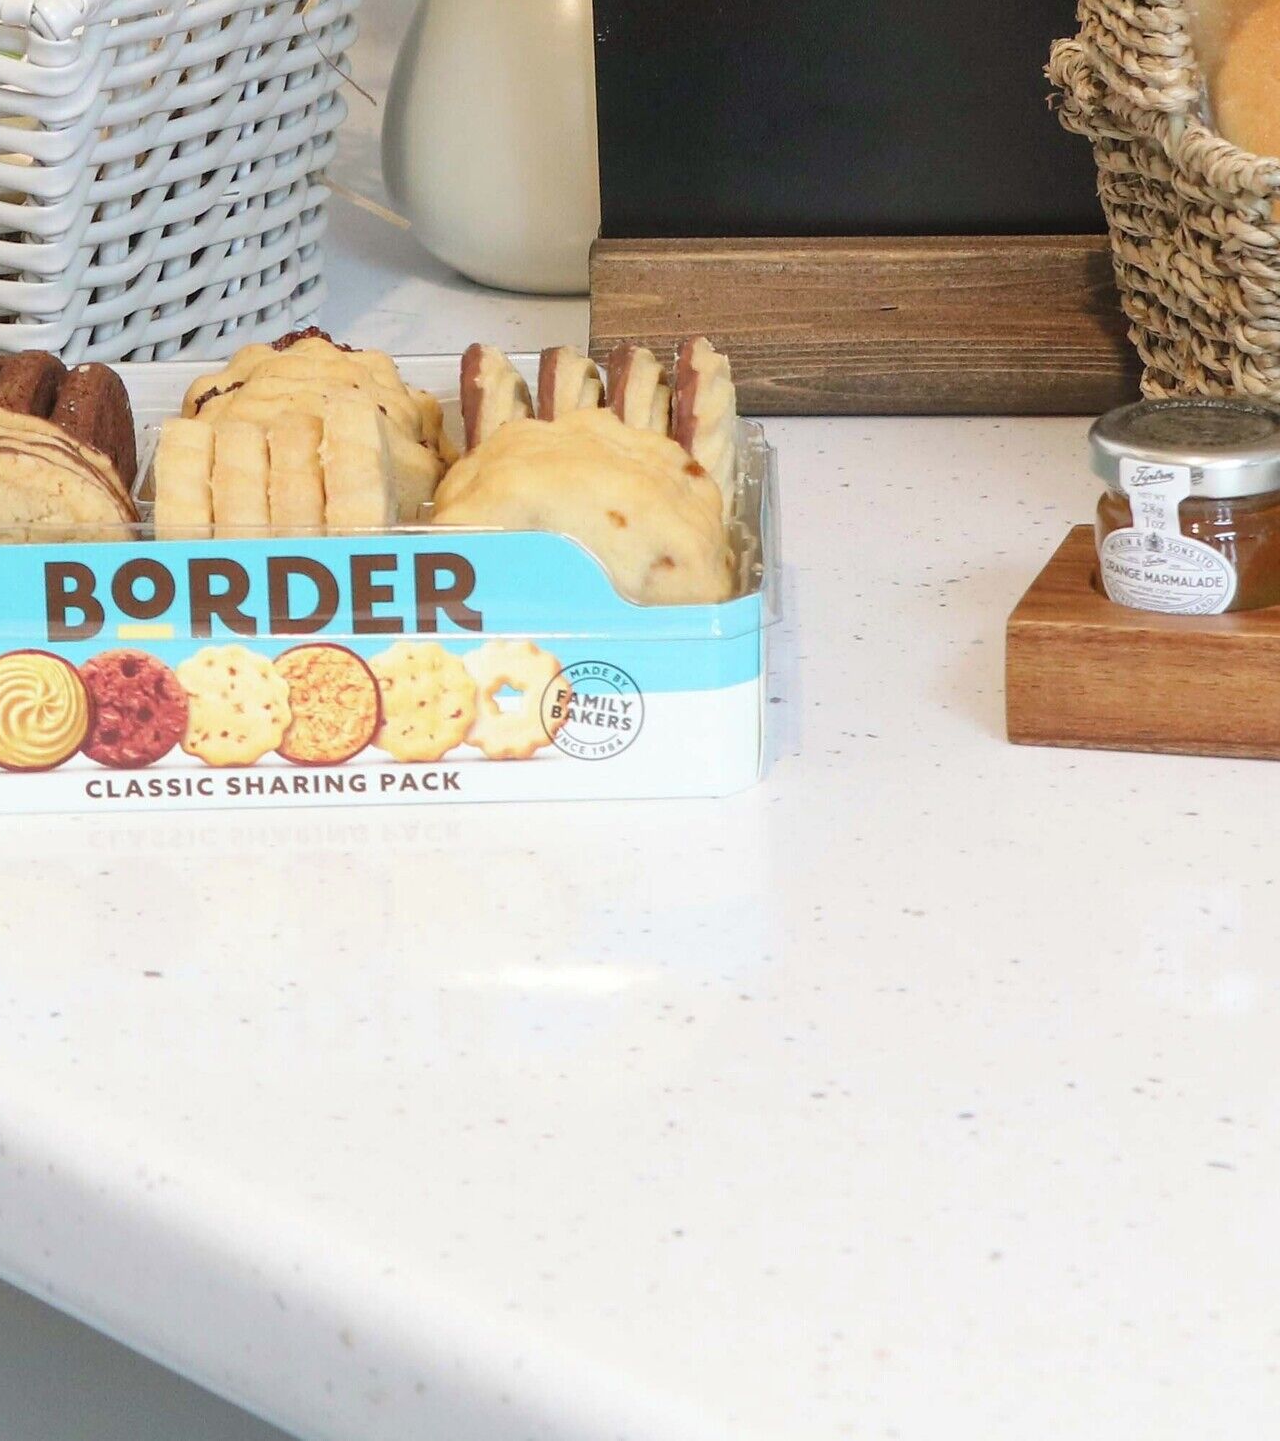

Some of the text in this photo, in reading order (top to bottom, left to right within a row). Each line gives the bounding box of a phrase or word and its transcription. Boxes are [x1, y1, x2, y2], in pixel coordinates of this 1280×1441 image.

[1104, 558, 1224, 588] ORANGE MARMALADE
[44, 552, 484, 643] BORDER
[570, 666, 629, 687] MADE BY
[556, 689, 633, 715] FAMILY
[550, 705, 632, 731] BAKERS
[85, 770, 462, 799] CLASSIC SHARING PACK
